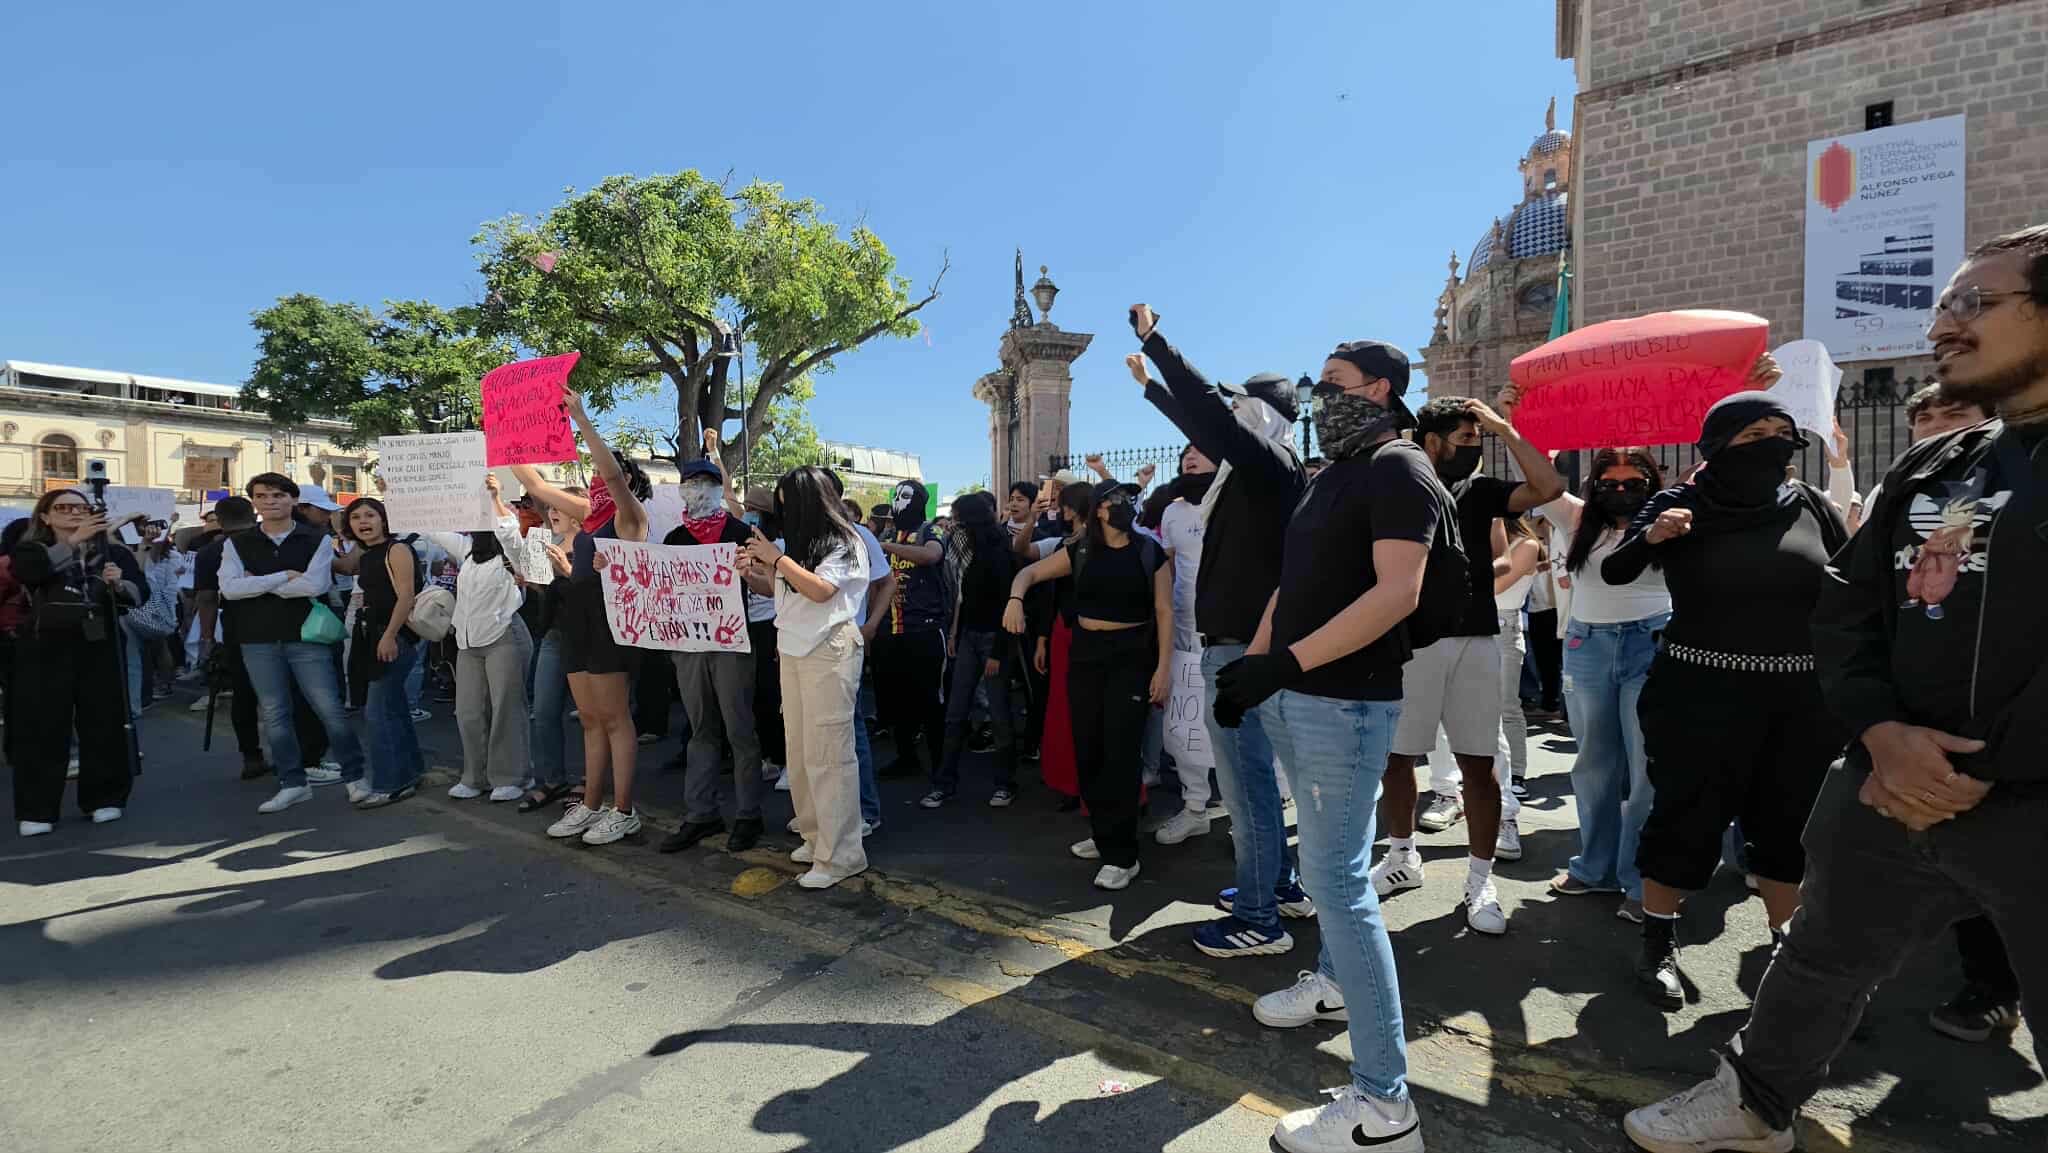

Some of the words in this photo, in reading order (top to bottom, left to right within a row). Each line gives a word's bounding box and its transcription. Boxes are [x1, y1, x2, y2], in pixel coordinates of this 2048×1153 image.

[1861, 176, 1918, 191] ALFONSO
[1921, 170, 1956, 182] VEGA
[1525, 353, 1569, 380] PARA
[1560, 385, 1589, 408] NO
[1600, 378, 1650, 404] HAYA
[1668, 367, 1725, 392] PAZ
[706, 595, 723, 611] NO
[1171, 695, 1199, 721] NO
